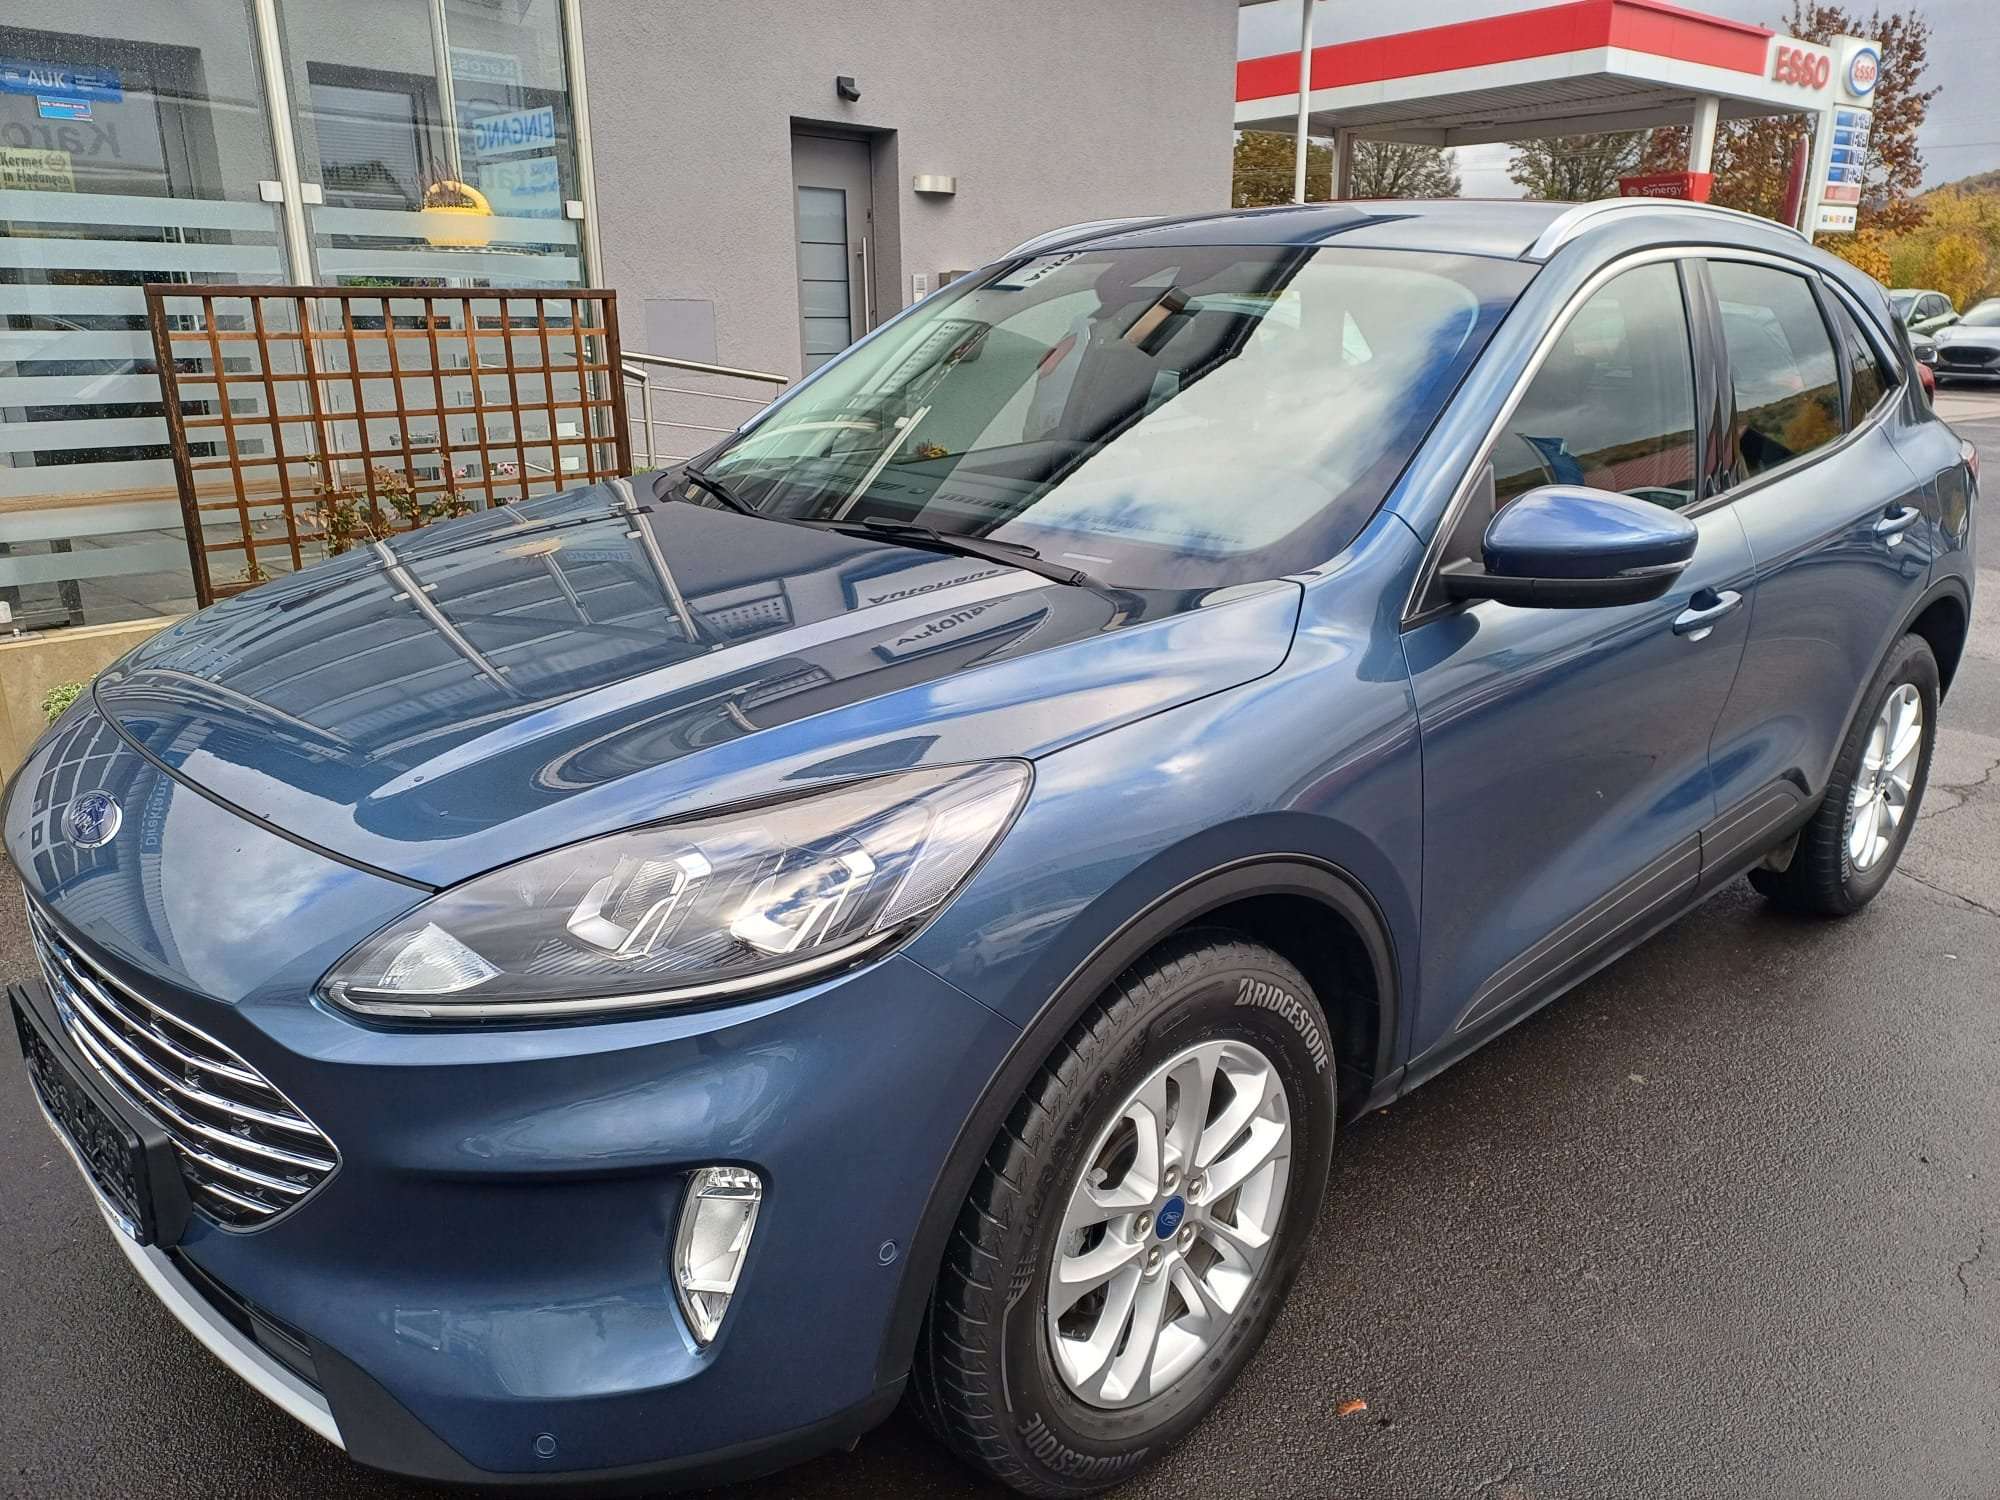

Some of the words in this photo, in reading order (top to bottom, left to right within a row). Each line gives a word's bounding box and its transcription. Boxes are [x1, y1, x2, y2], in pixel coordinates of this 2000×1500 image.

[1774, 46, 1830, 89] ESSO
[1642, 186, 1682, 197] Synergy
[1234, 978, 1328, 1074] BRIDGESTONE
